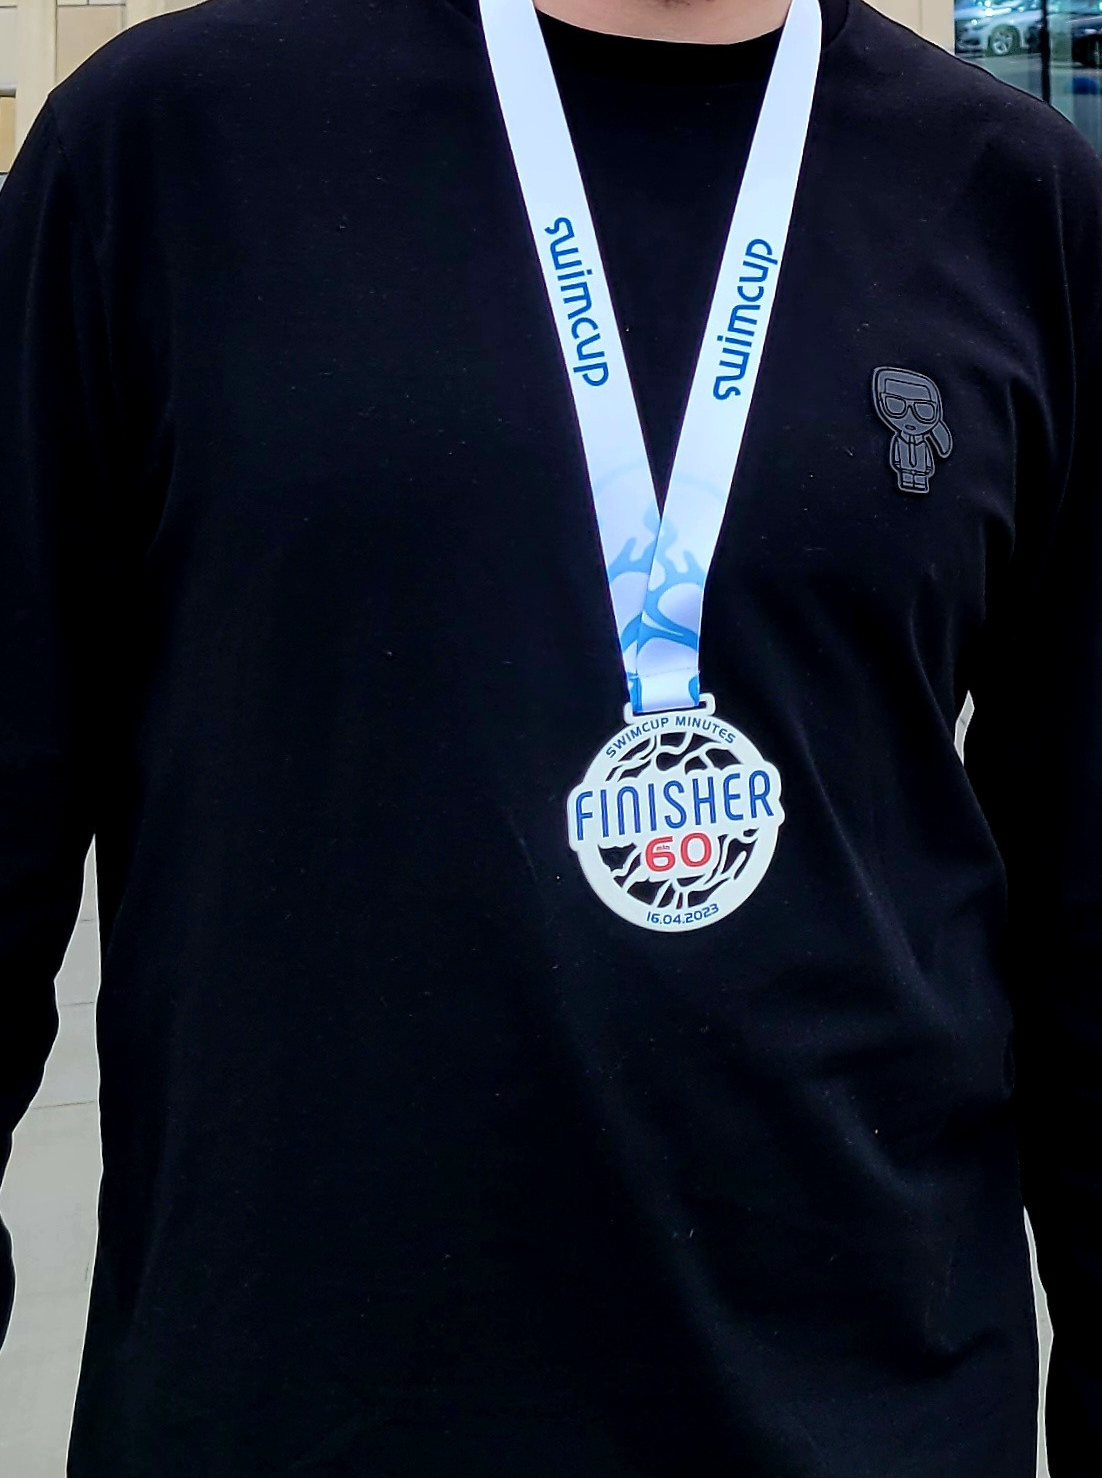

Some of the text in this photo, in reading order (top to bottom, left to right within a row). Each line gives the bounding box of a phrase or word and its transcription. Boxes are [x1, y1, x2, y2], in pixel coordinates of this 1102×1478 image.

[544, 217, 609, 387] swimcup
[712, 238, 778, 400] swimcup
[605, 715, 737, 759] SWIMCUP MINUTES
[575, 770, 775, 841] FINISHER
[645, 832, 712, 872] 60
[646, 903, 720, 925] 16.04.2023
